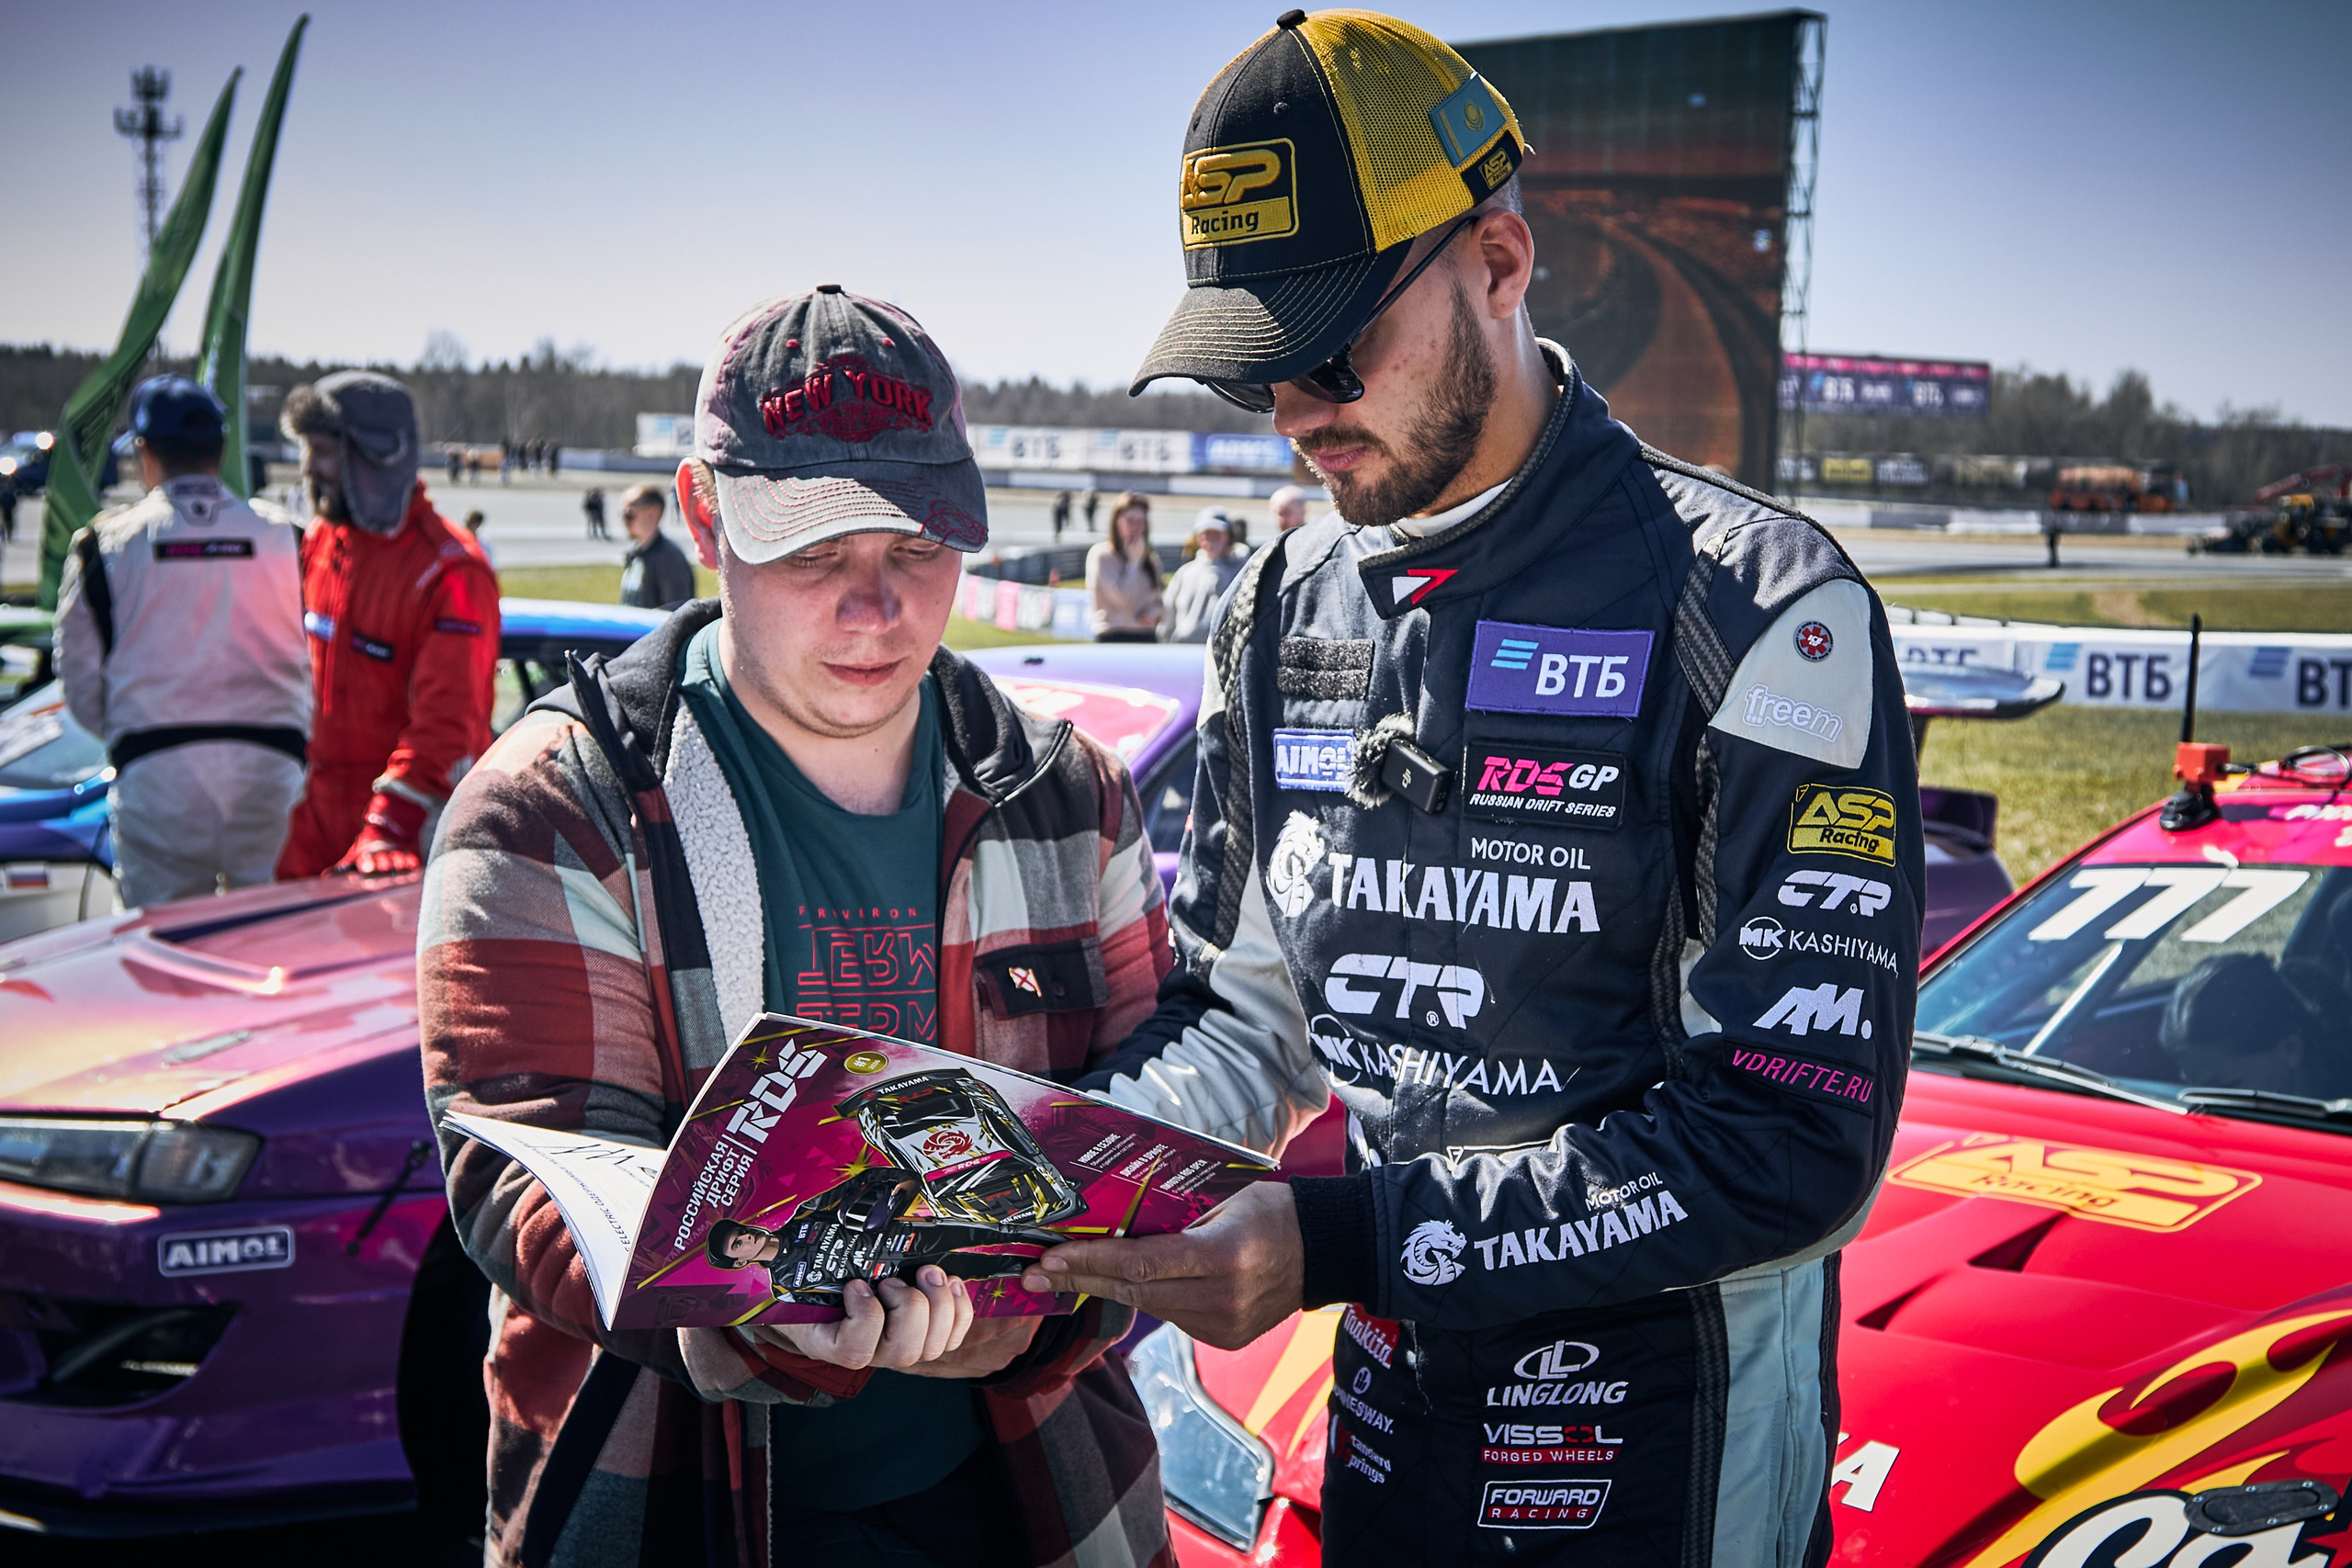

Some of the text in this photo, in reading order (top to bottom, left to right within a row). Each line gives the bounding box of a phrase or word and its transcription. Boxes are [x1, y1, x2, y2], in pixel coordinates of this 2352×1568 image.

[1182, 149, 1282, 208] ASP
[1484, 150, 1506, 179] ASP
[1192, 210, 1260, 234] Racing
[763, 373, 833, 434] NEW
[843, 369, 933, 426] YORK
[1534, 652, 1630, 698] ВТБ
[2086, 653, 2172, 702] ВТБ
[2299, 657, 2352, 709] ВТ
[1745, 686, 1842, 741] freem
[1476, 755, 1620, 796] RDS GP
[1469, 794, 1617, 818] RUSSIAN DRIFT SERIES
[1796, 790, 1894, 832] ASP
[1471, 837, 1591, 871] MOTOR OIL
[1819, 828, 1880, 852] Racing
[1328, 852, 1600, 934] TAKAYAMA
[1738, 927, 1899, 972] MK KASHIYAMA
[726, 1038, 828, 1144] RDS
[877, 1076, 930, 1095] TAKAYAMA
[1357, 1043, 1563, 1096] KASHIYAMA
[1732, 1049, 1874, 1103] VDRIFTE.RU
[705, 1147, 740, 1209] ДРИФТ
[720, 1155, 754, 1207] СЕРИЯ
[1585, 1172, 1663, 1212] MOTOR OIL
[1960, 1142, 2239, 1199] ASP
[1973, 1173, 2120, 1211] Racing
[674, 1141, 729, 1251] РОССИЙСКАЯ
[166, 1235, 287, 1269] AIMOL
[1475, 1190, 1689, 1271] TAKAYAMA
[1487, 1380, 1629, 1407] LINGLONG
[1484, 1423, 1623, 1445] VISSOL
[1484, 1450, 1614, 1462] FORGED WHEELS
[1490, 1488, 1600, 1506] FORWARD
[1491, 1508, 1588, 1520] RACING
